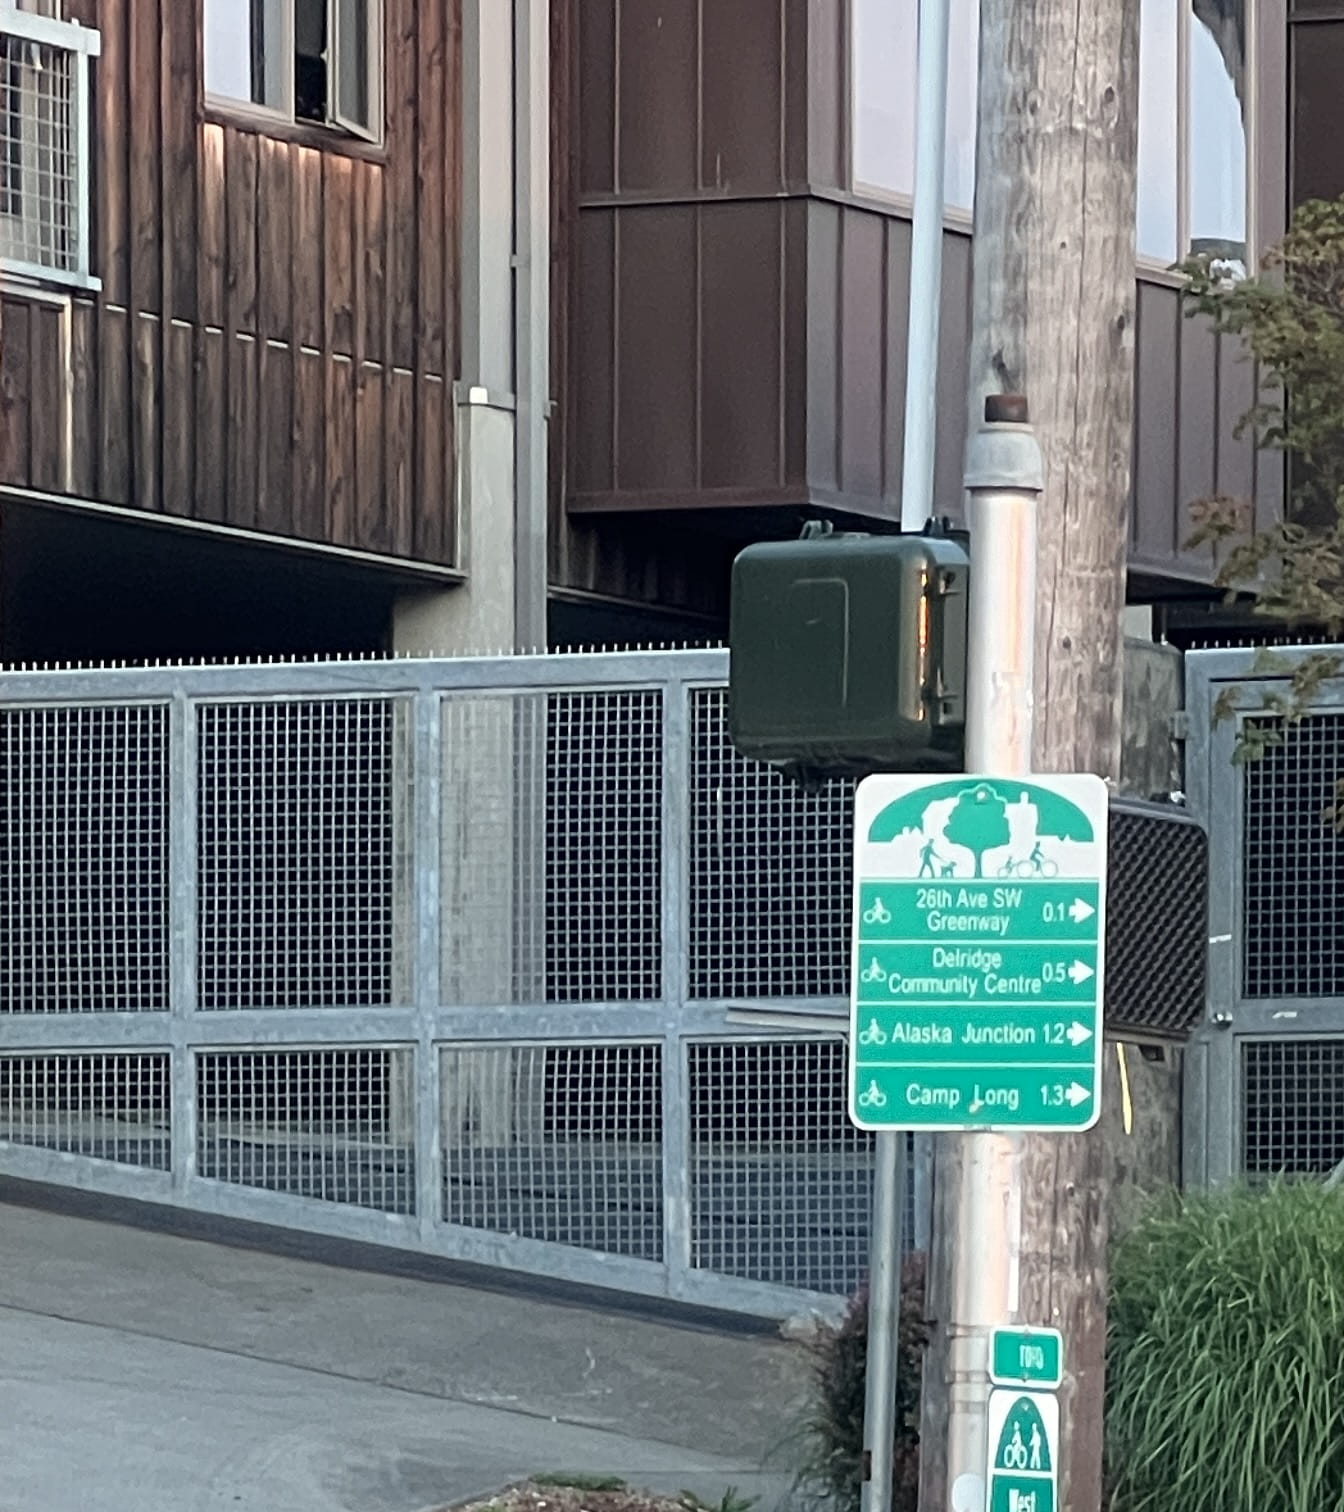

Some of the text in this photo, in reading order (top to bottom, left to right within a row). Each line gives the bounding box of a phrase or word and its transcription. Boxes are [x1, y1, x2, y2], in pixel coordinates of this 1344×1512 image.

[916, 888, 1023, 908] 26th Ave SW
[927, 910, 1010, 936] Greenway
[1043, 902, 1066, 922] 0.1
[932, 948, 1002, 973] Delridge
[1042, 962, 1066, 983] 0.5
[888, 973, 1041, 998] Community Centre
[891, 1022, 1065, 1045] Alaska Junction 1.2
[905, 1084, 1064, 1111] Camp Long 1.3
